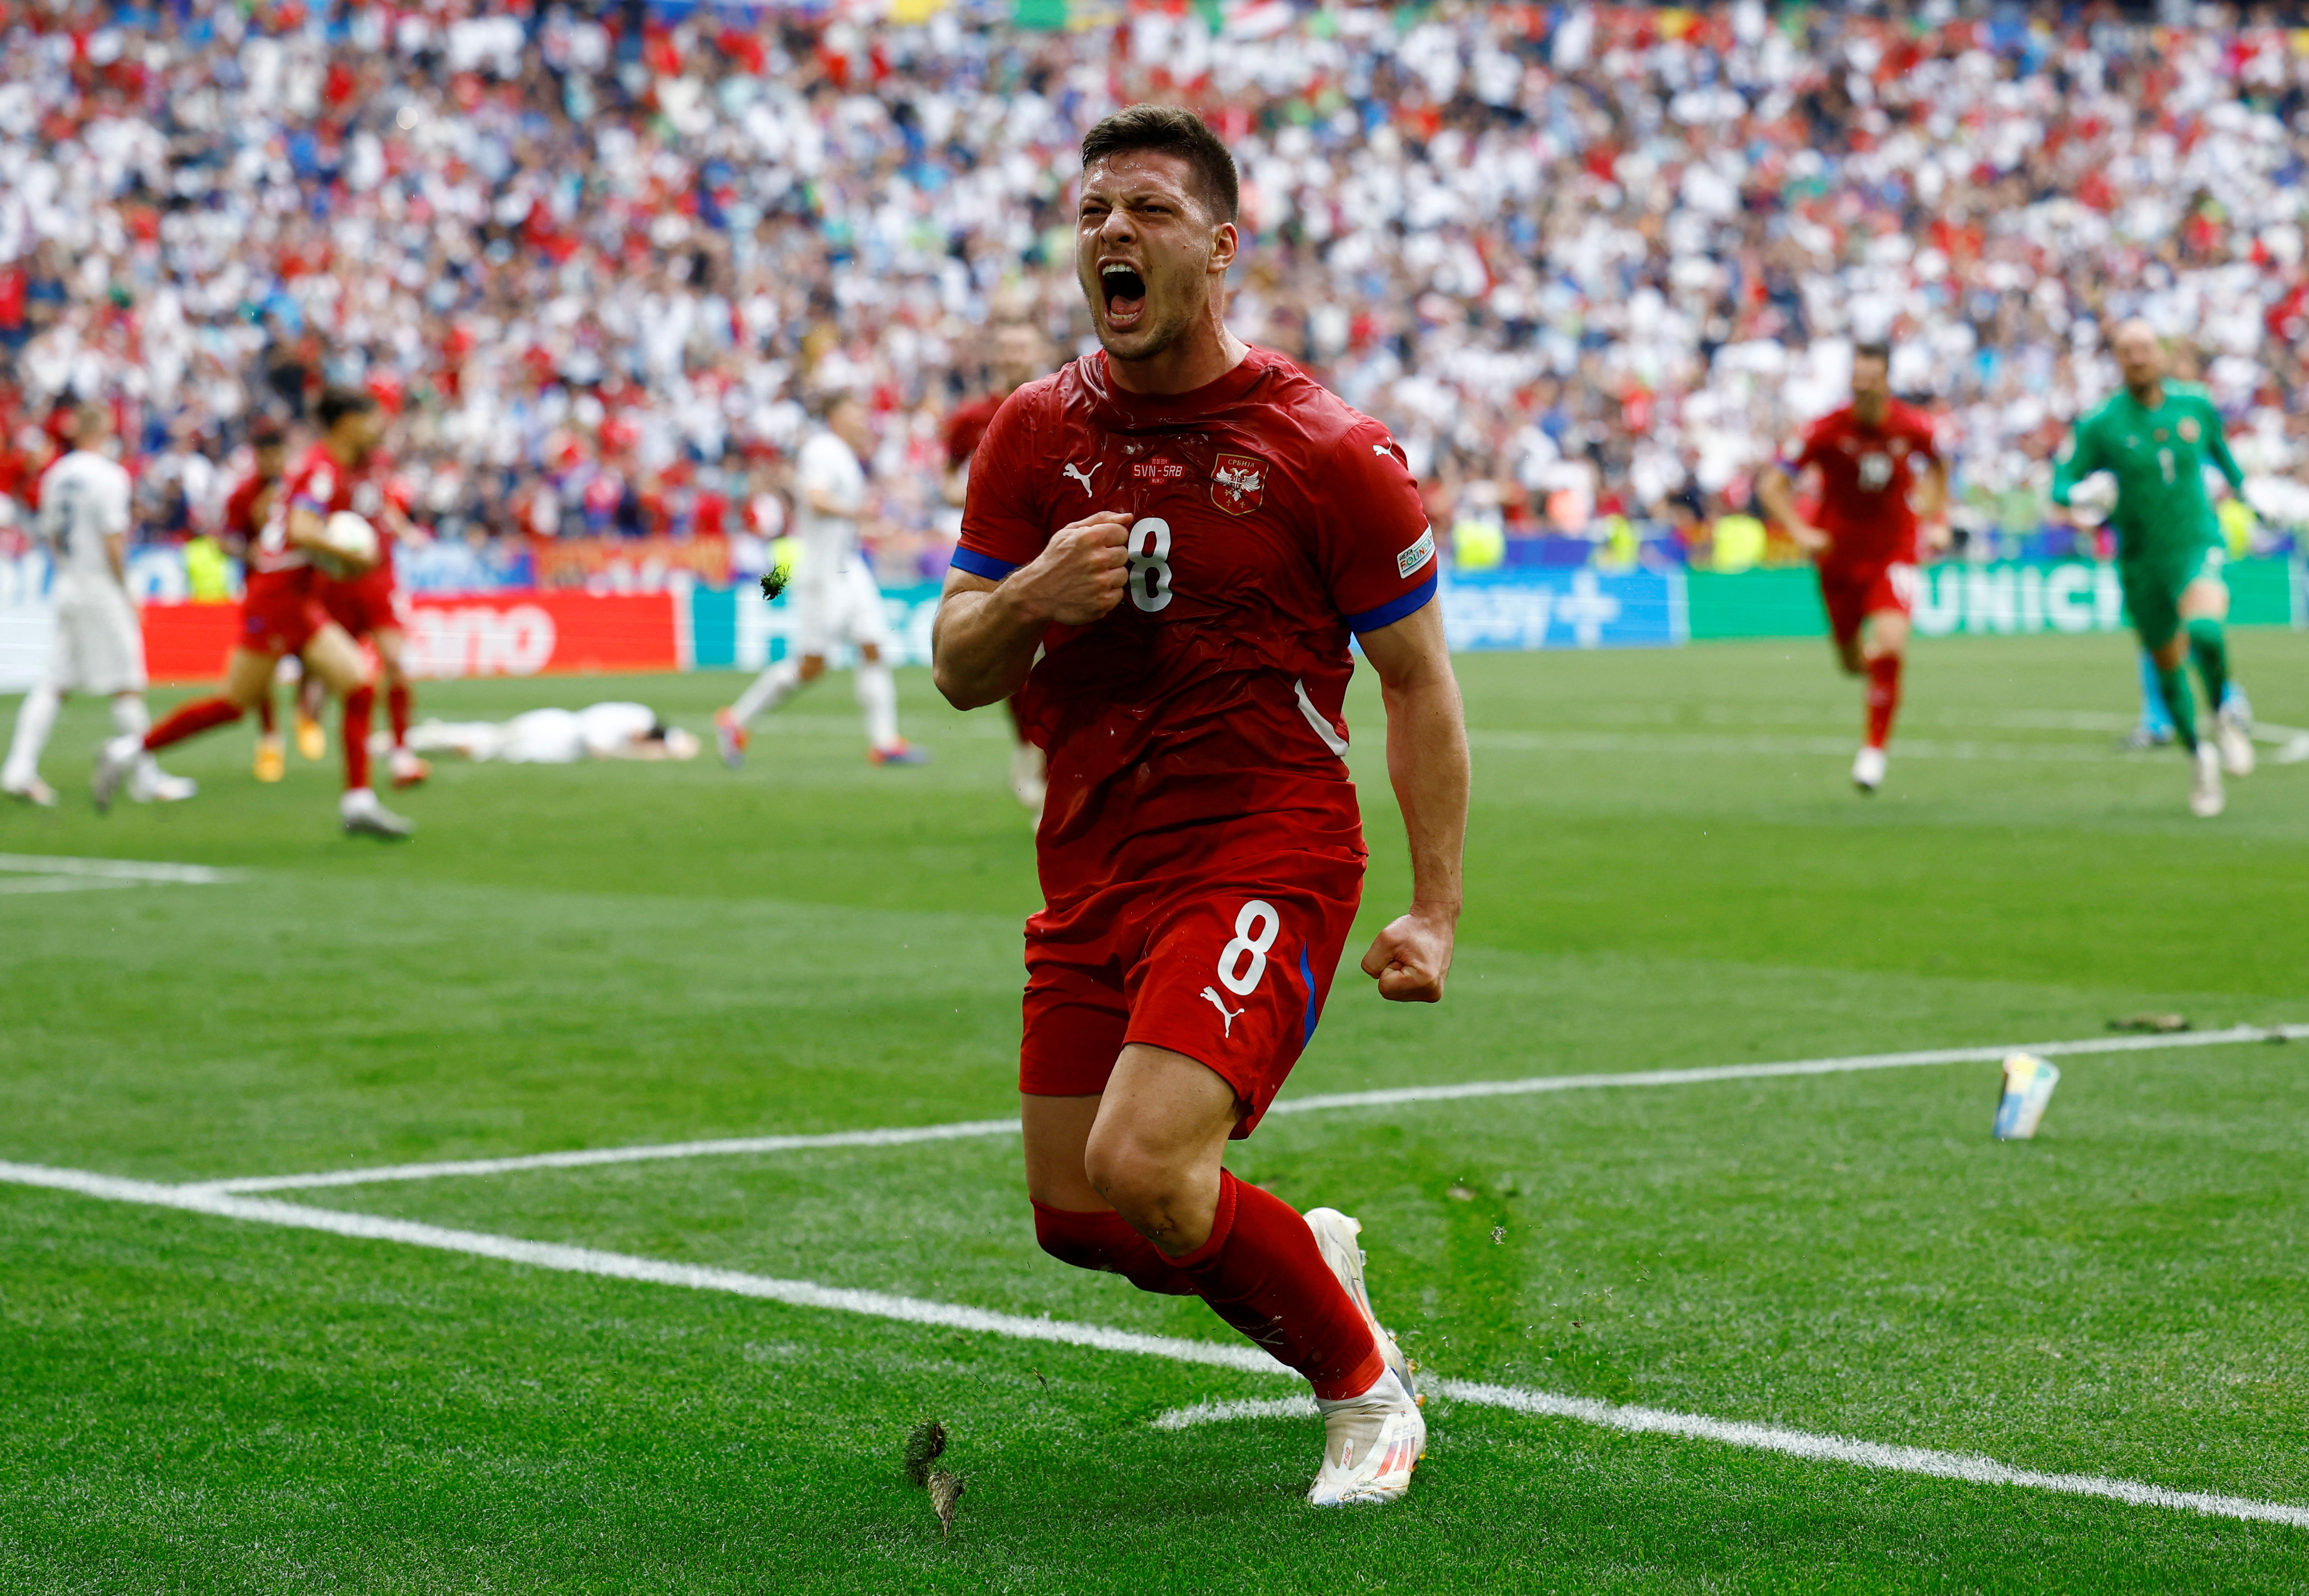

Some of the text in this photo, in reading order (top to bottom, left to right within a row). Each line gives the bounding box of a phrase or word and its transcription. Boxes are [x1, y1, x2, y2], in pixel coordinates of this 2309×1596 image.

[1228, 459, 1254, 468] СРБИЈА
[1399, 549, 1413, 561] UEFA
[1128, 517, 1172, 612] 8
[1217, 900, 1280, 996] 8
[1392, 1422, 1417, 1440] F50
